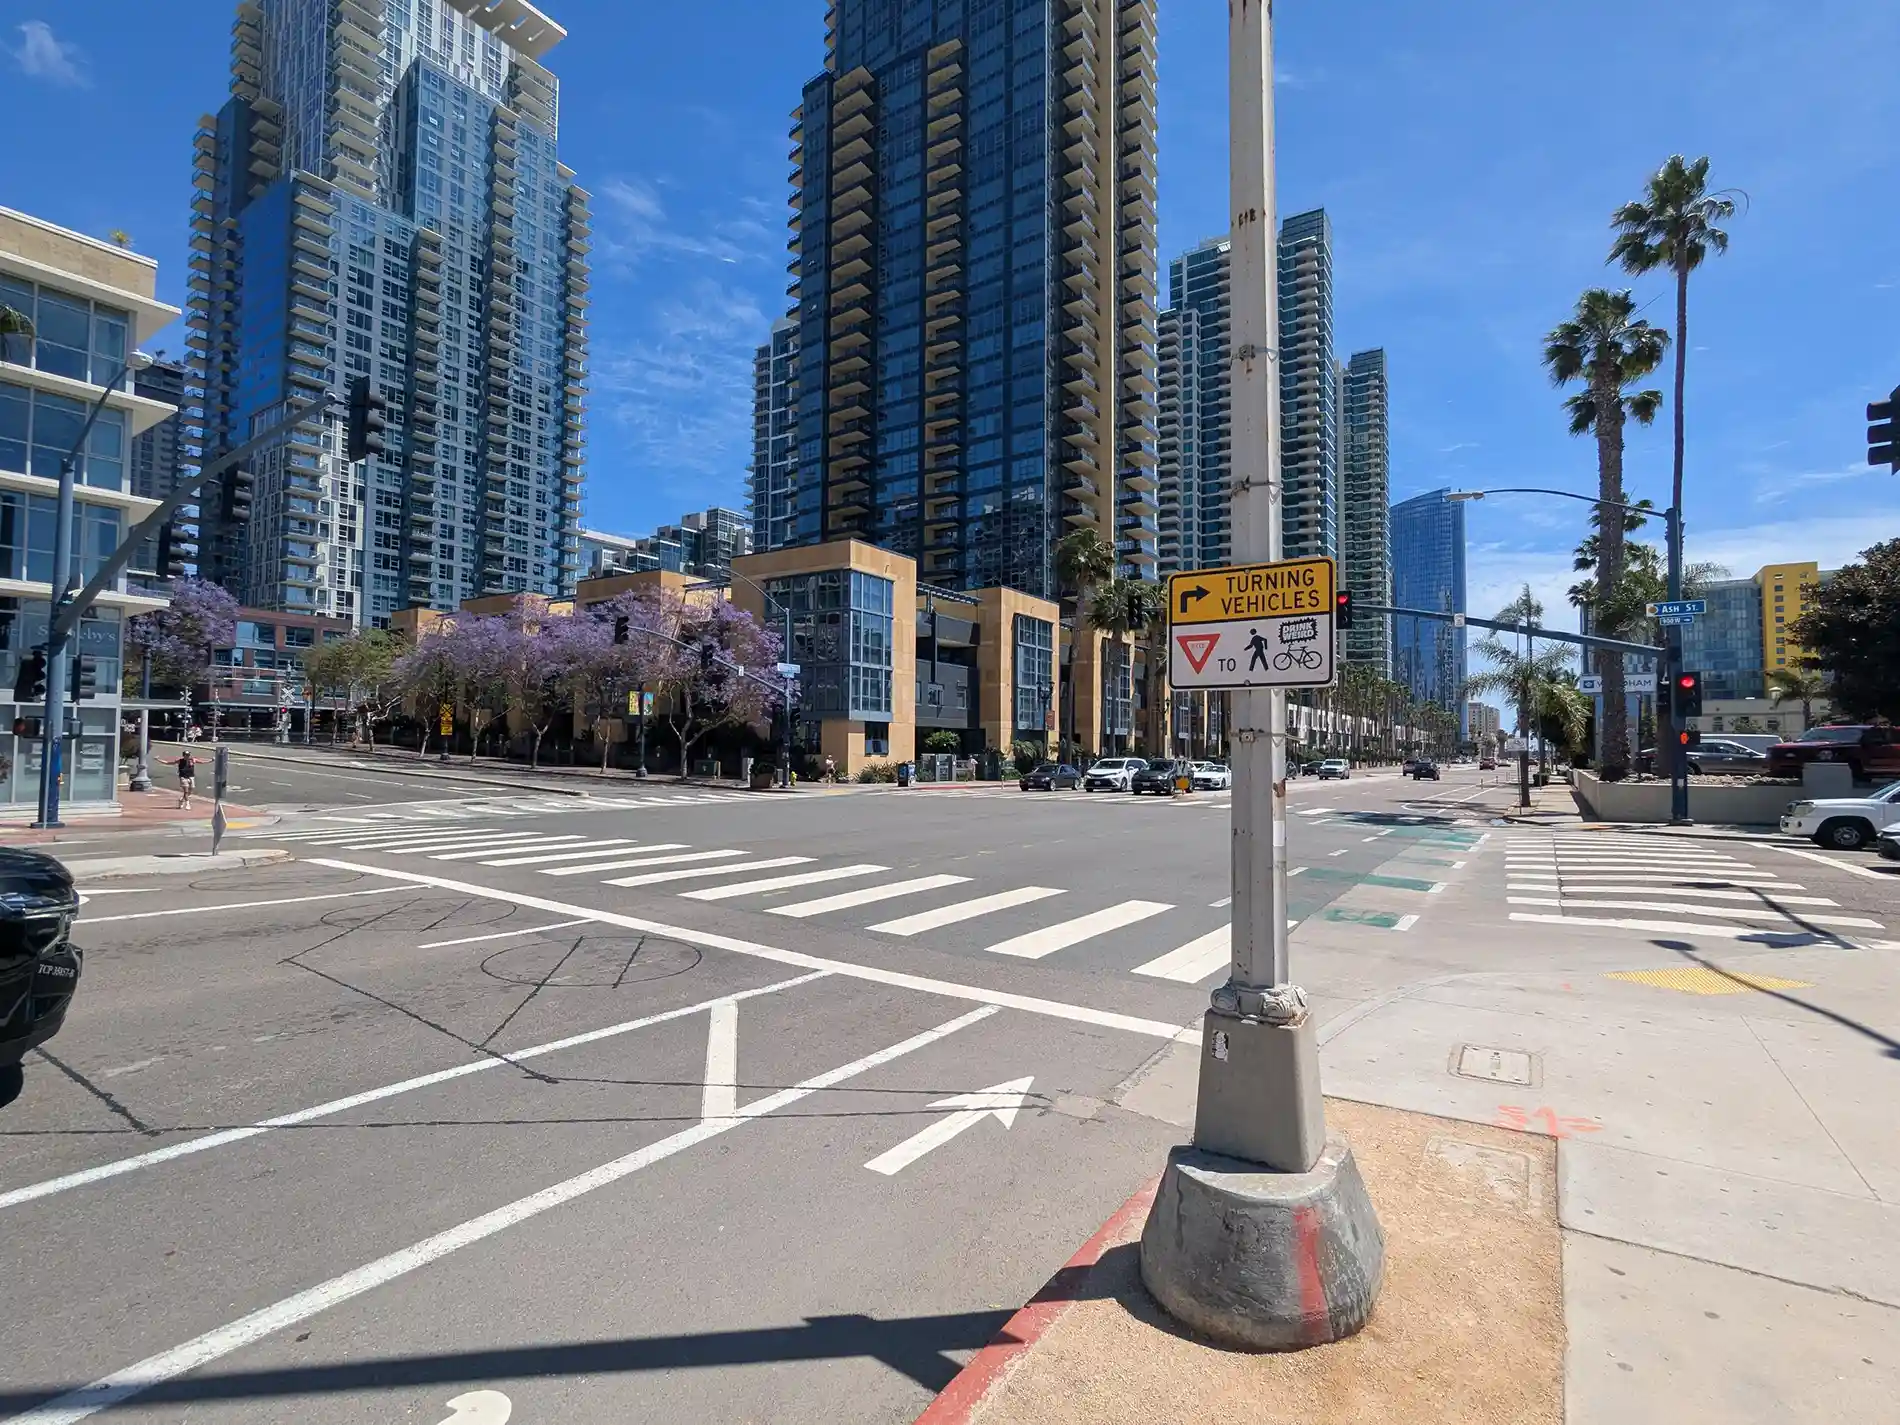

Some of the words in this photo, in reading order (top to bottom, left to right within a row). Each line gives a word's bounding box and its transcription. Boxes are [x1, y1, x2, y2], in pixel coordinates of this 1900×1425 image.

[1226, 568, 1315, 594] TURNING
[1221, 589, 1320, 615] VEHICLES
[1662, 605, 1680, 613] ASH
[1283, 622, 1313, 633] DRINK
[1283, 629, 1315, 640] WEIRD
[1217, 657, 1236, 672] TO
[1596, 679, 1652, 687] WDHAM
